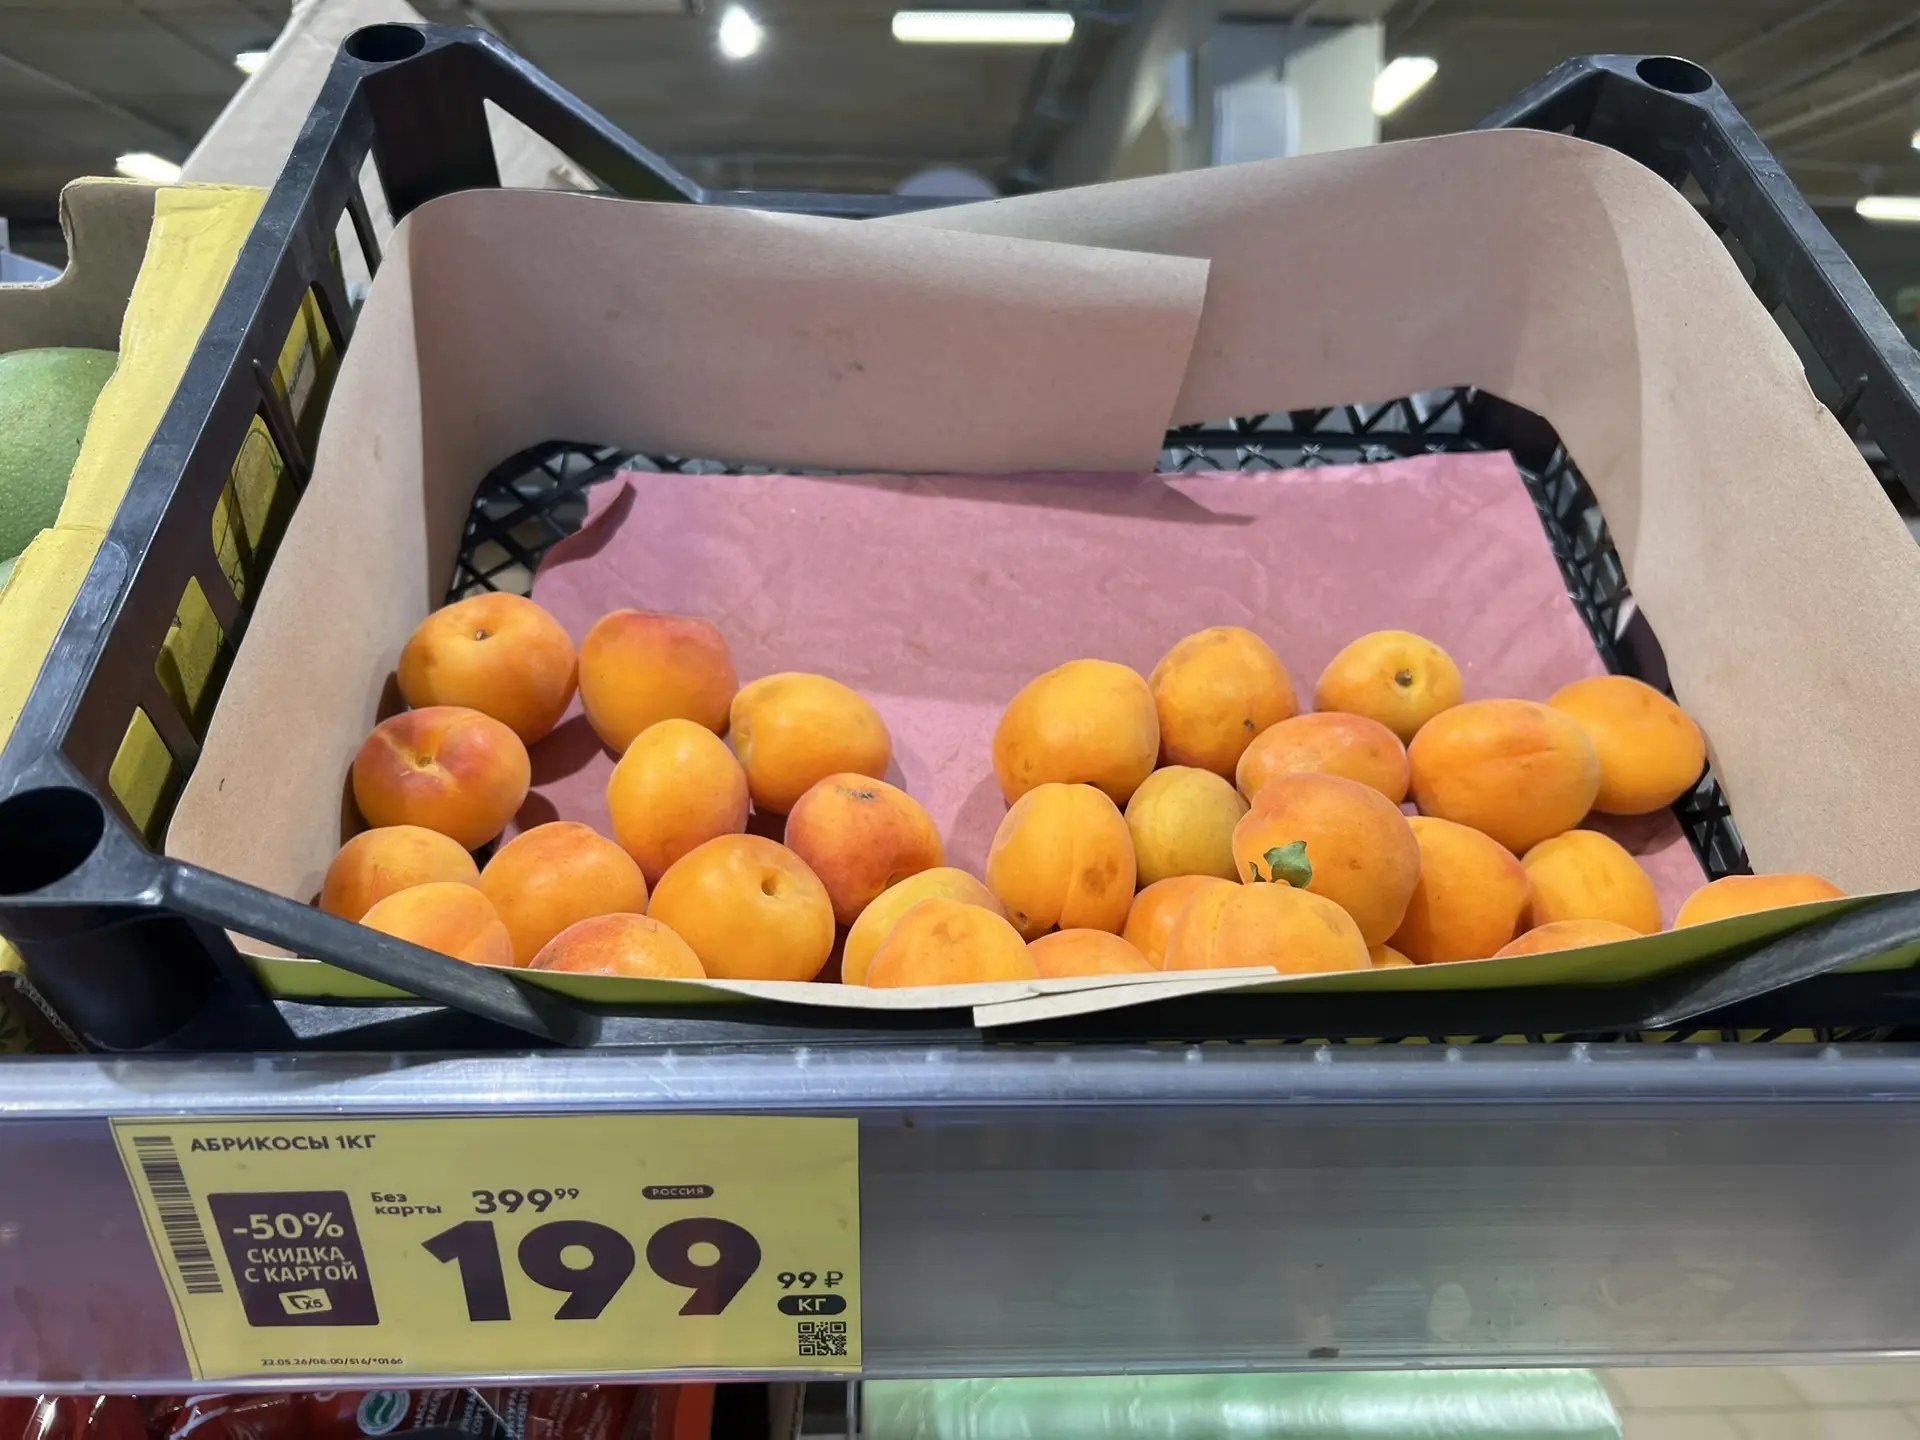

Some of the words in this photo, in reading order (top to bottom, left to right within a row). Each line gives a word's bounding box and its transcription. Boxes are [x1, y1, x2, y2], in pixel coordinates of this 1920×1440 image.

[190, 1135, 330, 1152] АБРИКОСЫ
[336, 1134, 377, 1150] 1КГ
[370, 1191, 408, 1203] Без
[651, 1186, 705, 1197] РОССИЯ
[374, 1204, 443, 1218] карты
[232, 1211, 345, 1241] -50%
[247, 1246, 345, 1265] СКИДКА
[244, 1268, 260, 1283] С
[264, 1260, 358, 1283] КАРТОЙ
[420, 1216, 762, 1322] 199
[797, 1297, 827, 1312] КГ
